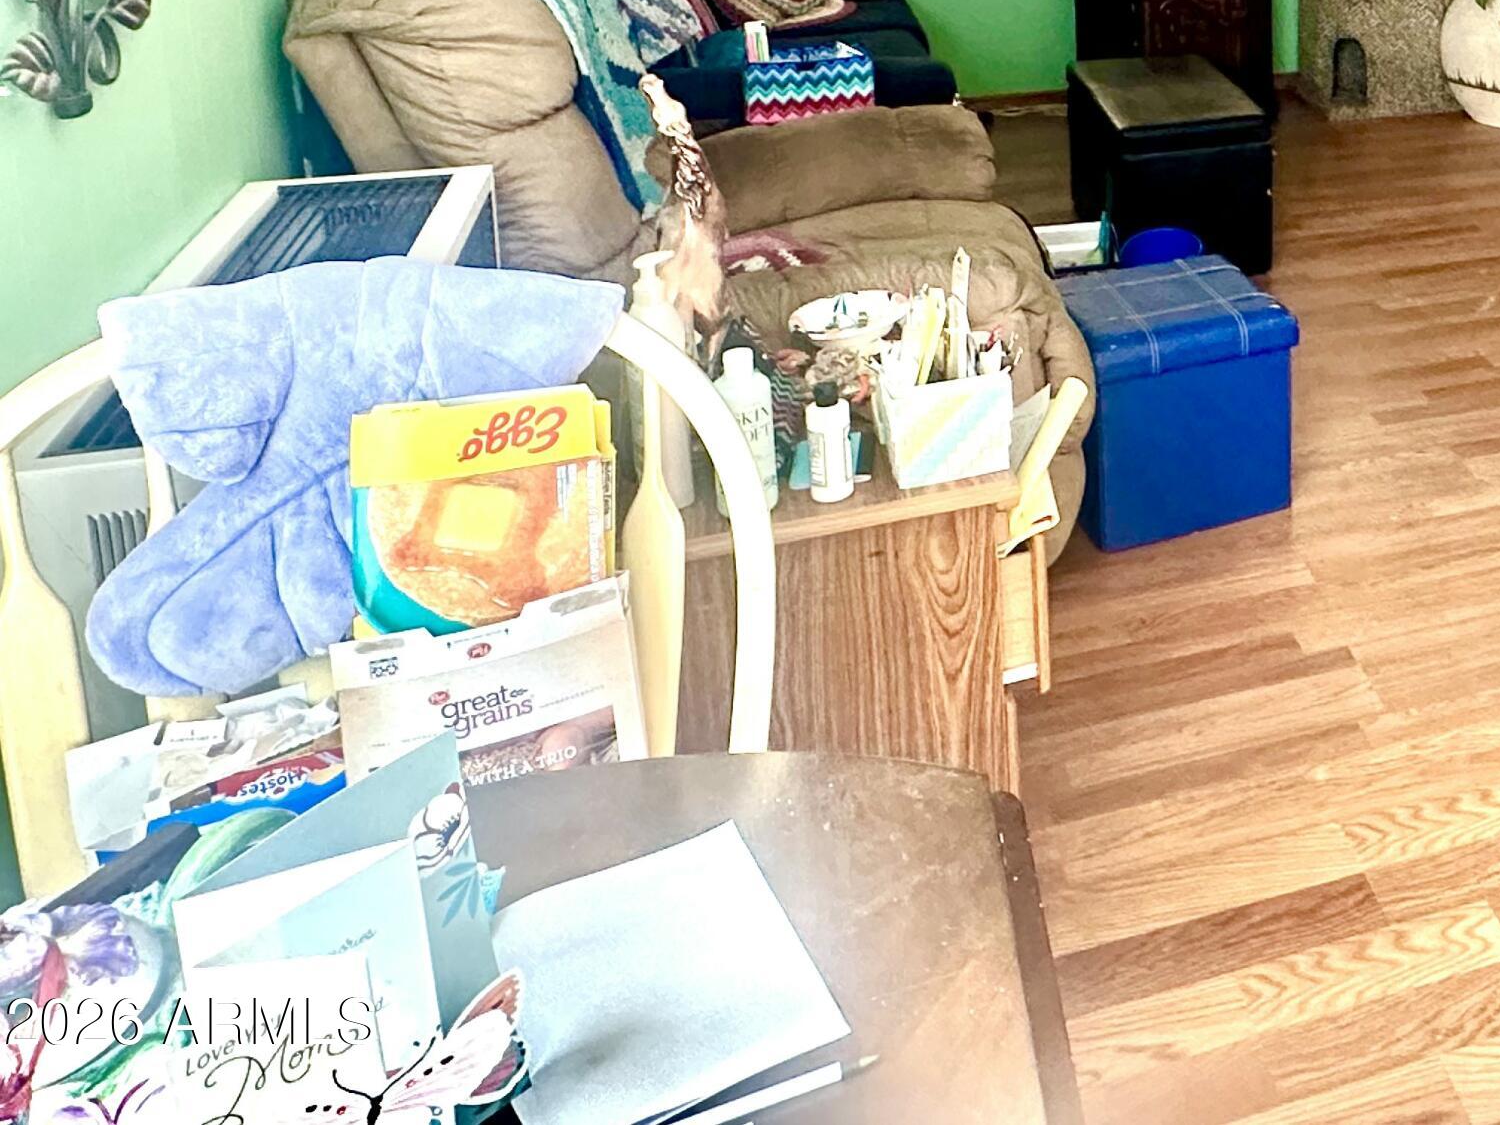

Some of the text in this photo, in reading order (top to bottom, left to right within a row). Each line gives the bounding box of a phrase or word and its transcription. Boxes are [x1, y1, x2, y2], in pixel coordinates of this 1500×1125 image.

[457, 405, 567, 462] Eggo
[441, 685, 508, 728] great
[454, 698, 533, 739] grains
[240, 772, 305, 797] Hostes
[467, 745, 578, 787] WITH A TRIO
